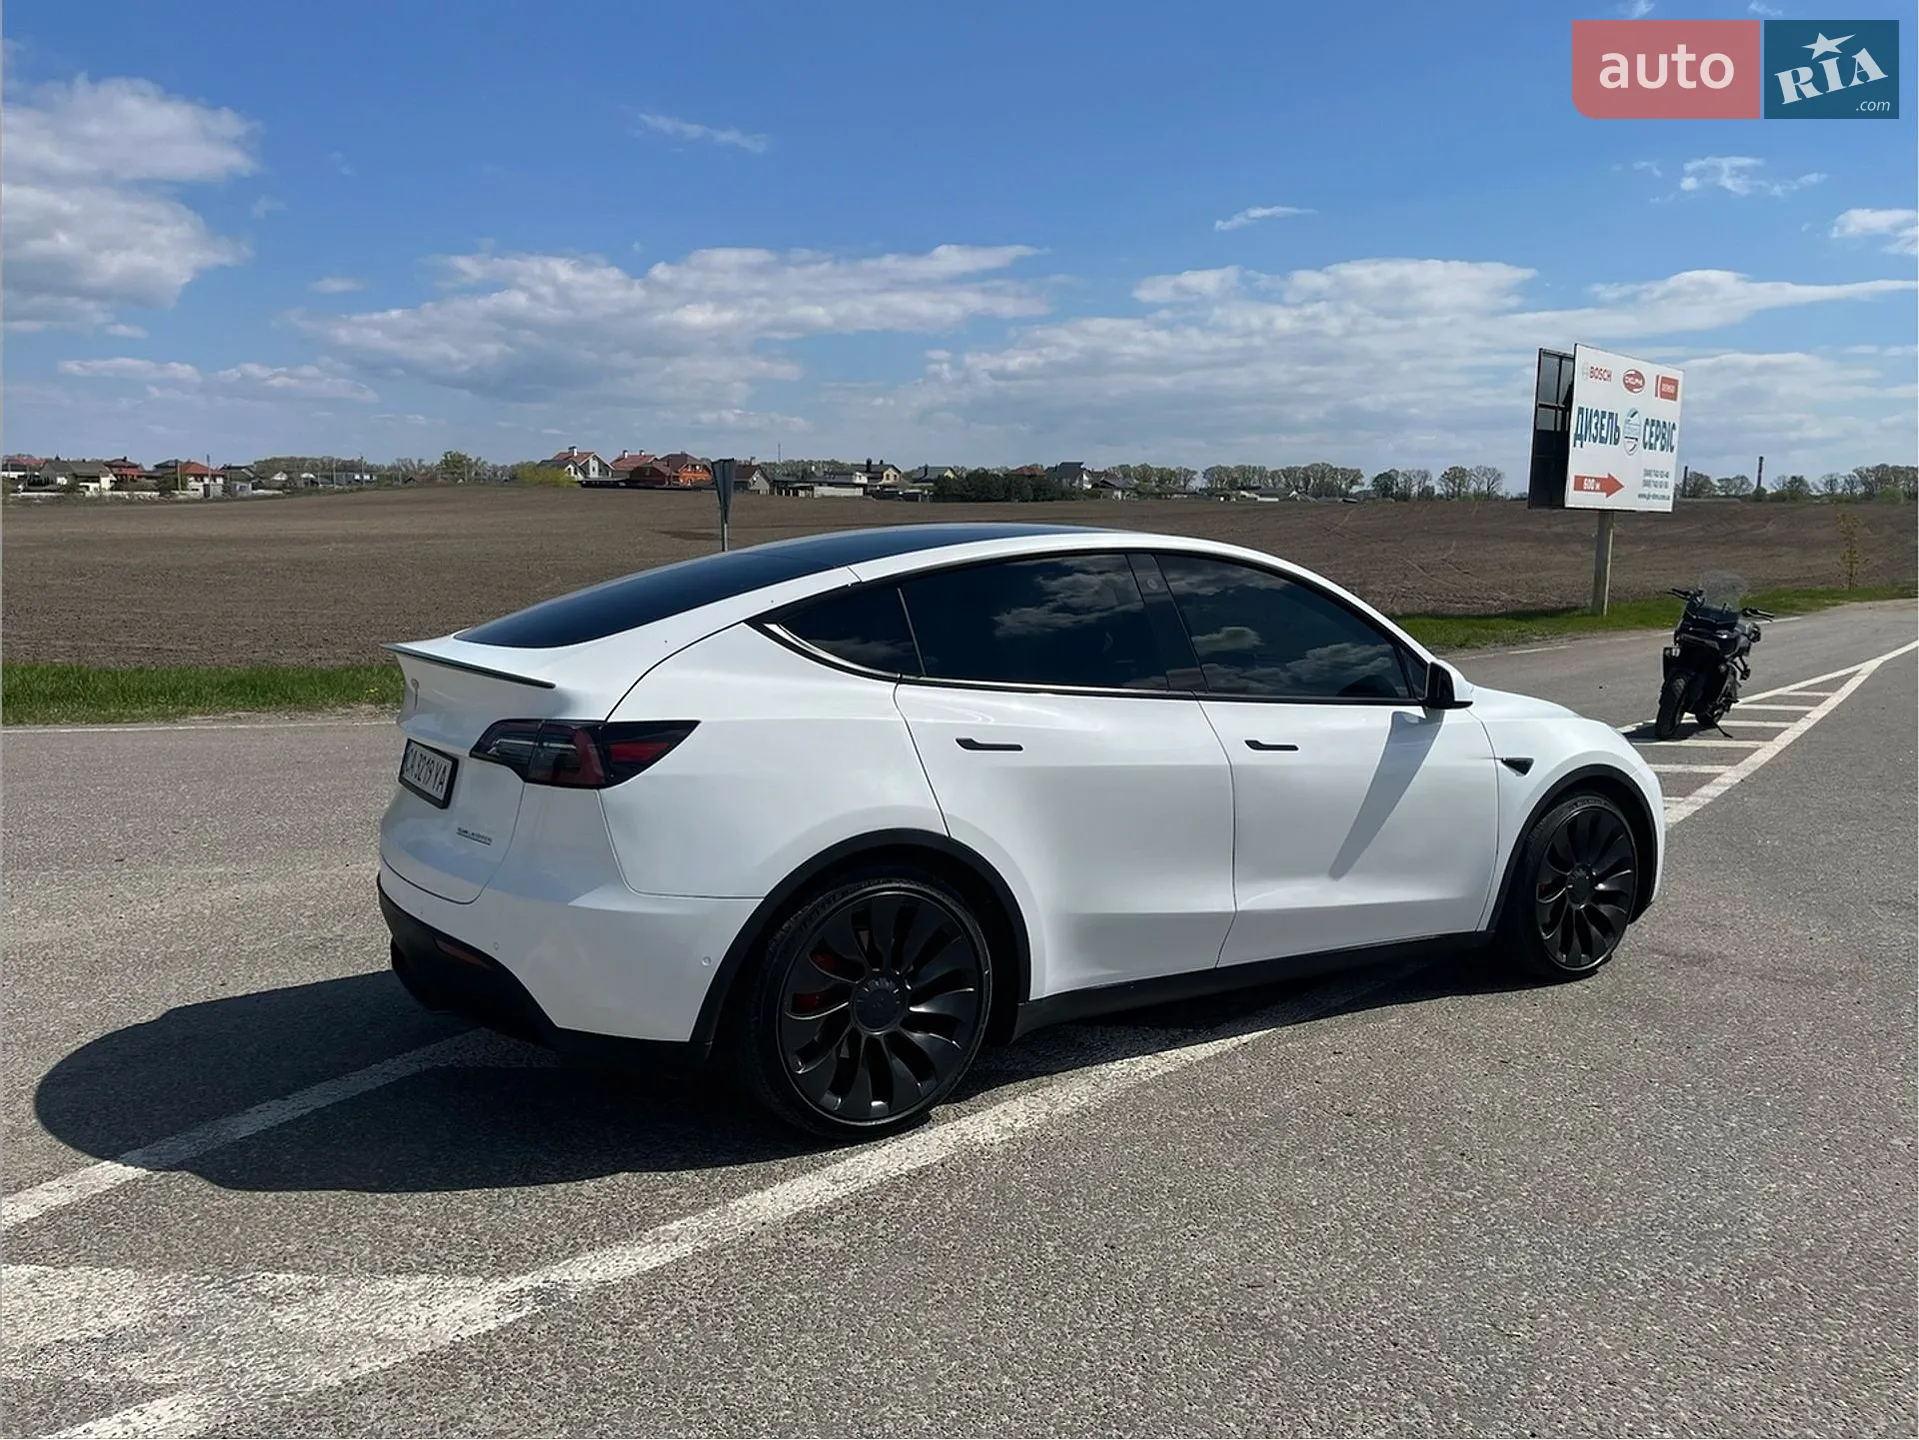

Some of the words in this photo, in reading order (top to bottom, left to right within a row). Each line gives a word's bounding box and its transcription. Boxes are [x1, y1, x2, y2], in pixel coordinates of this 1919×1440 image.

[1589, 365, 1612, 383] BOSCH
[1573, 406, 1621, 448] ДИЗЕЛЬ
[1642, 418, 1677, 453] СЕРВІС
